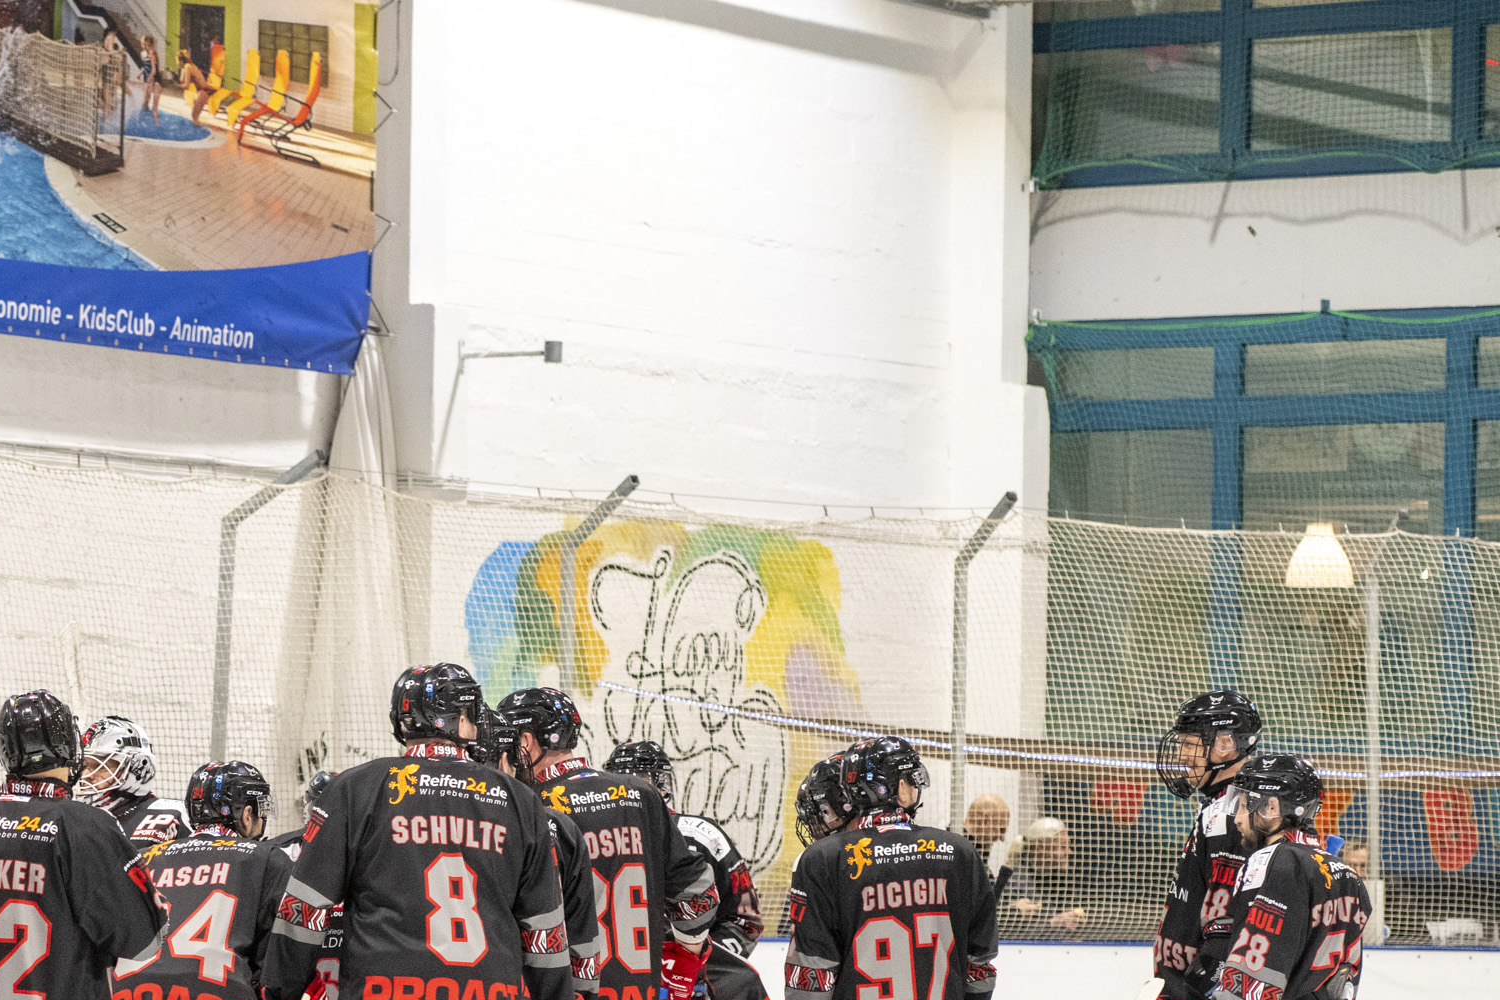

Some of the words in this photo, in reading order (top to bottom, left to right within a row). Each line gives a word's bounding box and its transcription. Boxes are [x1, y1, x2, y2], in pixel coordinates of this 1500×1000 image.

[78, 304, 156, 338] KidsClub
[170, 316, 255, 349] Animation
[433, 745, 458, 756] 1996
[563, 760, 584, 771] 1996
[11, 782, 33, 794] 1996
[419, 774, 508, 801] Reifen24.de
[570, 785, 641, 806] Reifen24.de
[419, 788, 436, 796] Wir
[439, 789, 470, 800] geben
[473, 792, 508, 808] Gummi!
[573, 806, 589, 814] Wir
[591, 802, 617, 812] geben
[392, 815, 507, 855] SCHULTE
[167, 839, 258, 851] Reifen24.de
[874, 839, 954, 858] Reifen24.de
[875, 857, 891, 865] Wir
[894, 854, 922, 863] geben
[925, 852, 954, 861] Gummi!
[424, 852, 489, 967] 8
[1226, 927, 1270, 972] 28
